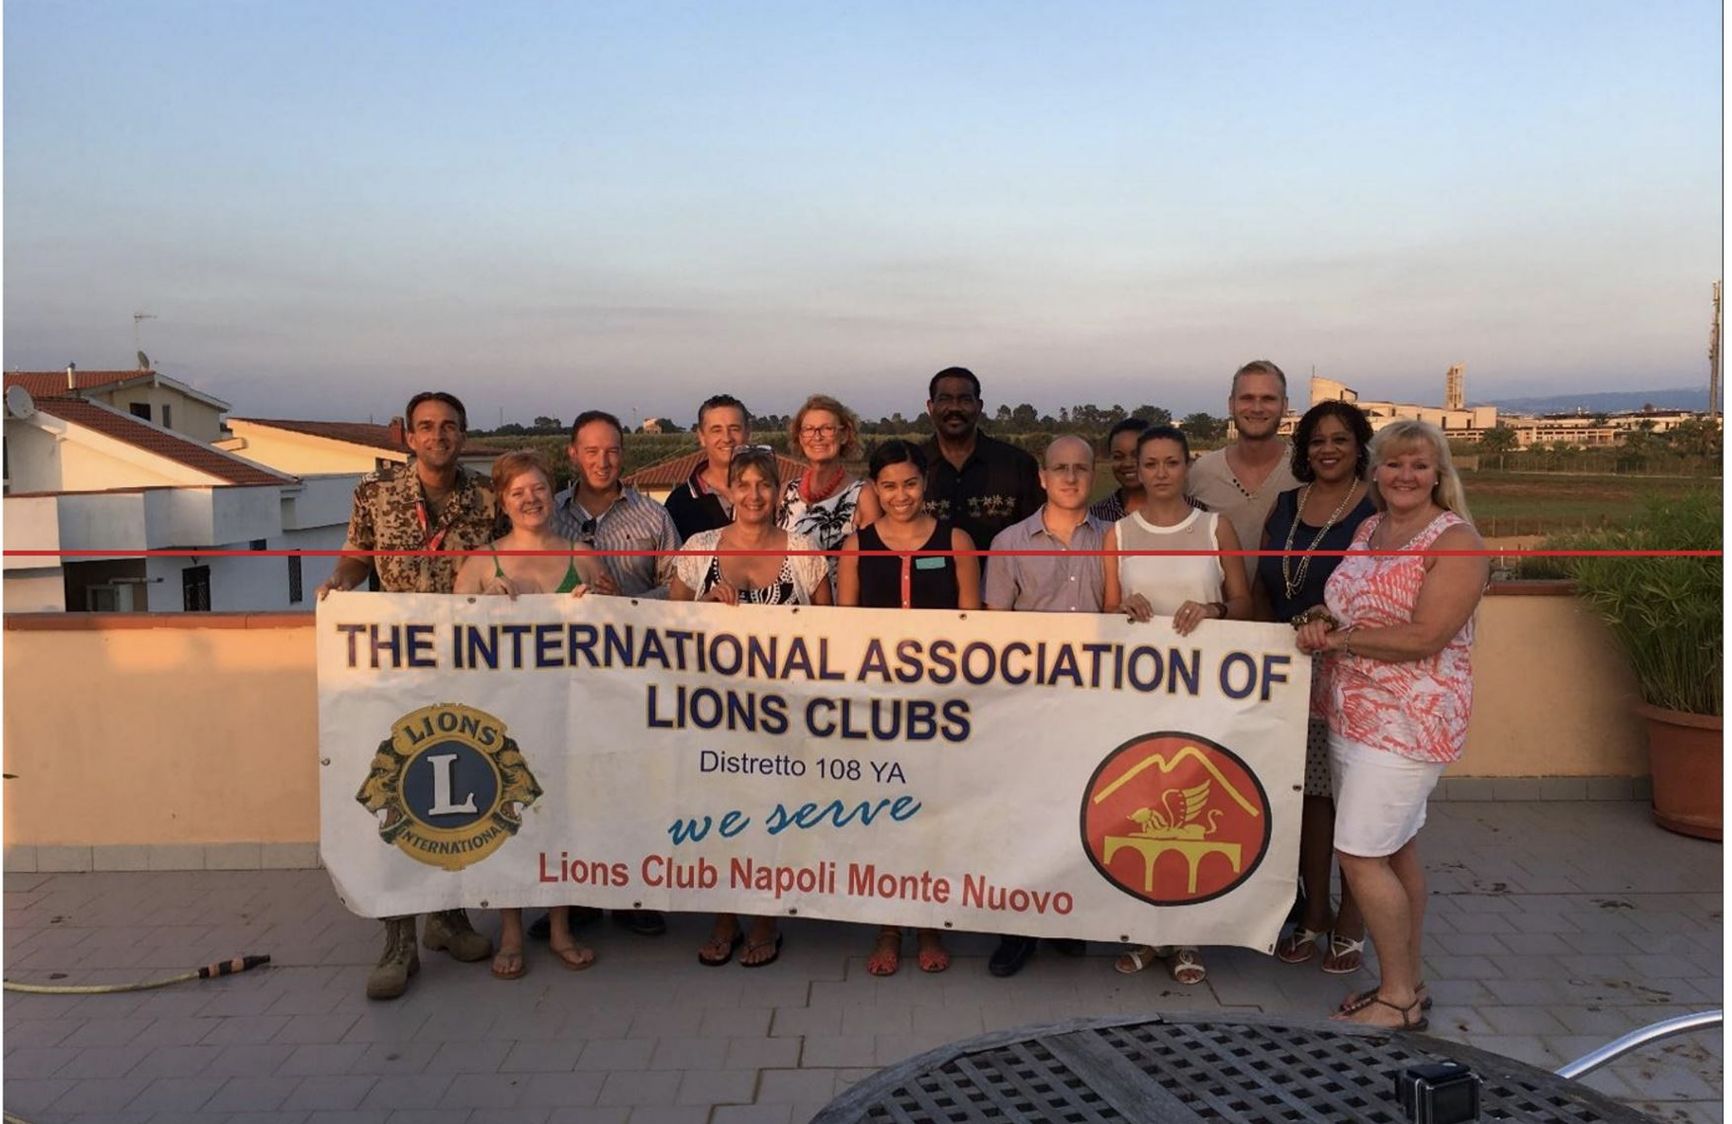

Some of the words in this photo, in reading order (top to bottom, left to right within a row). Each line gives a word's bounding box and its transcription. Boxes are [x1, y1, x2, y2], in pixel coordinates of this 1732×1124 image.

[337, 623, 437, 669] THE
[452, 624, 845, 681] INTERNATIONAL
[857, 637, 1201, 696] ASSOCIATION
[1218, 651, 1292, 701] OF
[403, 711, 499, 746] LIONS
[646, 685, 789, 735] LIONS
[804, 698, 971, 743] CLUBS
[427, 753, 478, 816] L
[700, 750, 806, 777] Distretto
[815, 758, 861, 781] 108
[870, 761, 906, 784] YA
[668, 810, 750, 846] we
[766, 794, 922, 836] serve
[539, 852, 629, 887] Lions
[642, 855, 718, 890] Club
[730, 857, 837, 899] Napoli
[848, 862, 950, 904] Monte
[962, 873, 1074, 916] Nuovo
